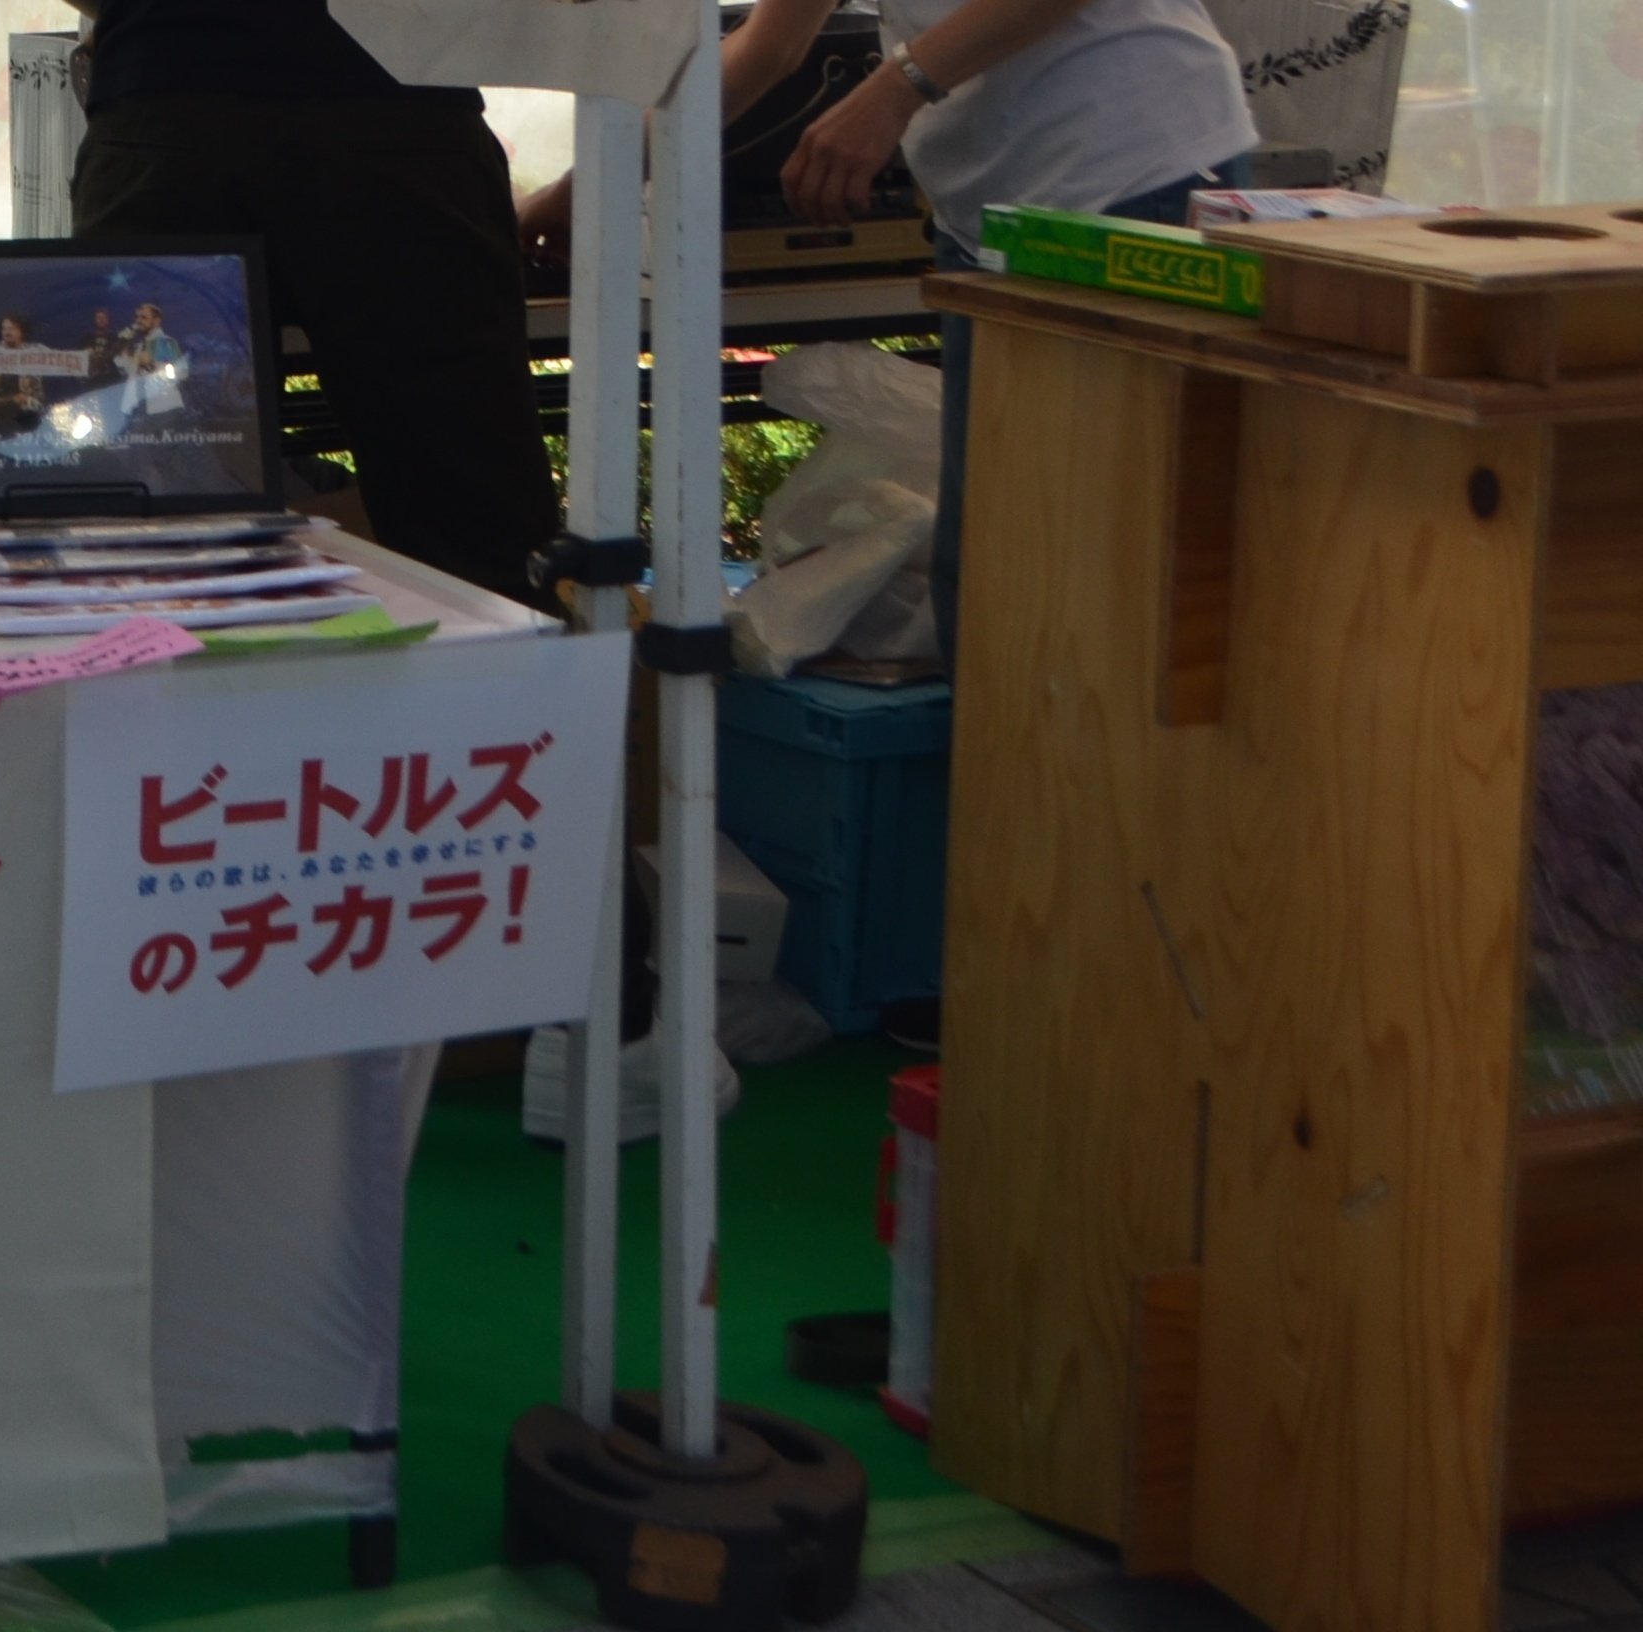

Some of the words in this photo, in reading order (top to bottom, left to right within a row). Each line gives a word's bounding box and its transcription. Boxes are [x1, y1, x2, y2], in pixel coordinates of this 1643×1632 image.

[139, 729, 556, 866] ビートルズ
[129, 864, 531, 996] のチカラ!
[137, 830, 538, 898] 彼らの歌は、あなたを幸せにする
